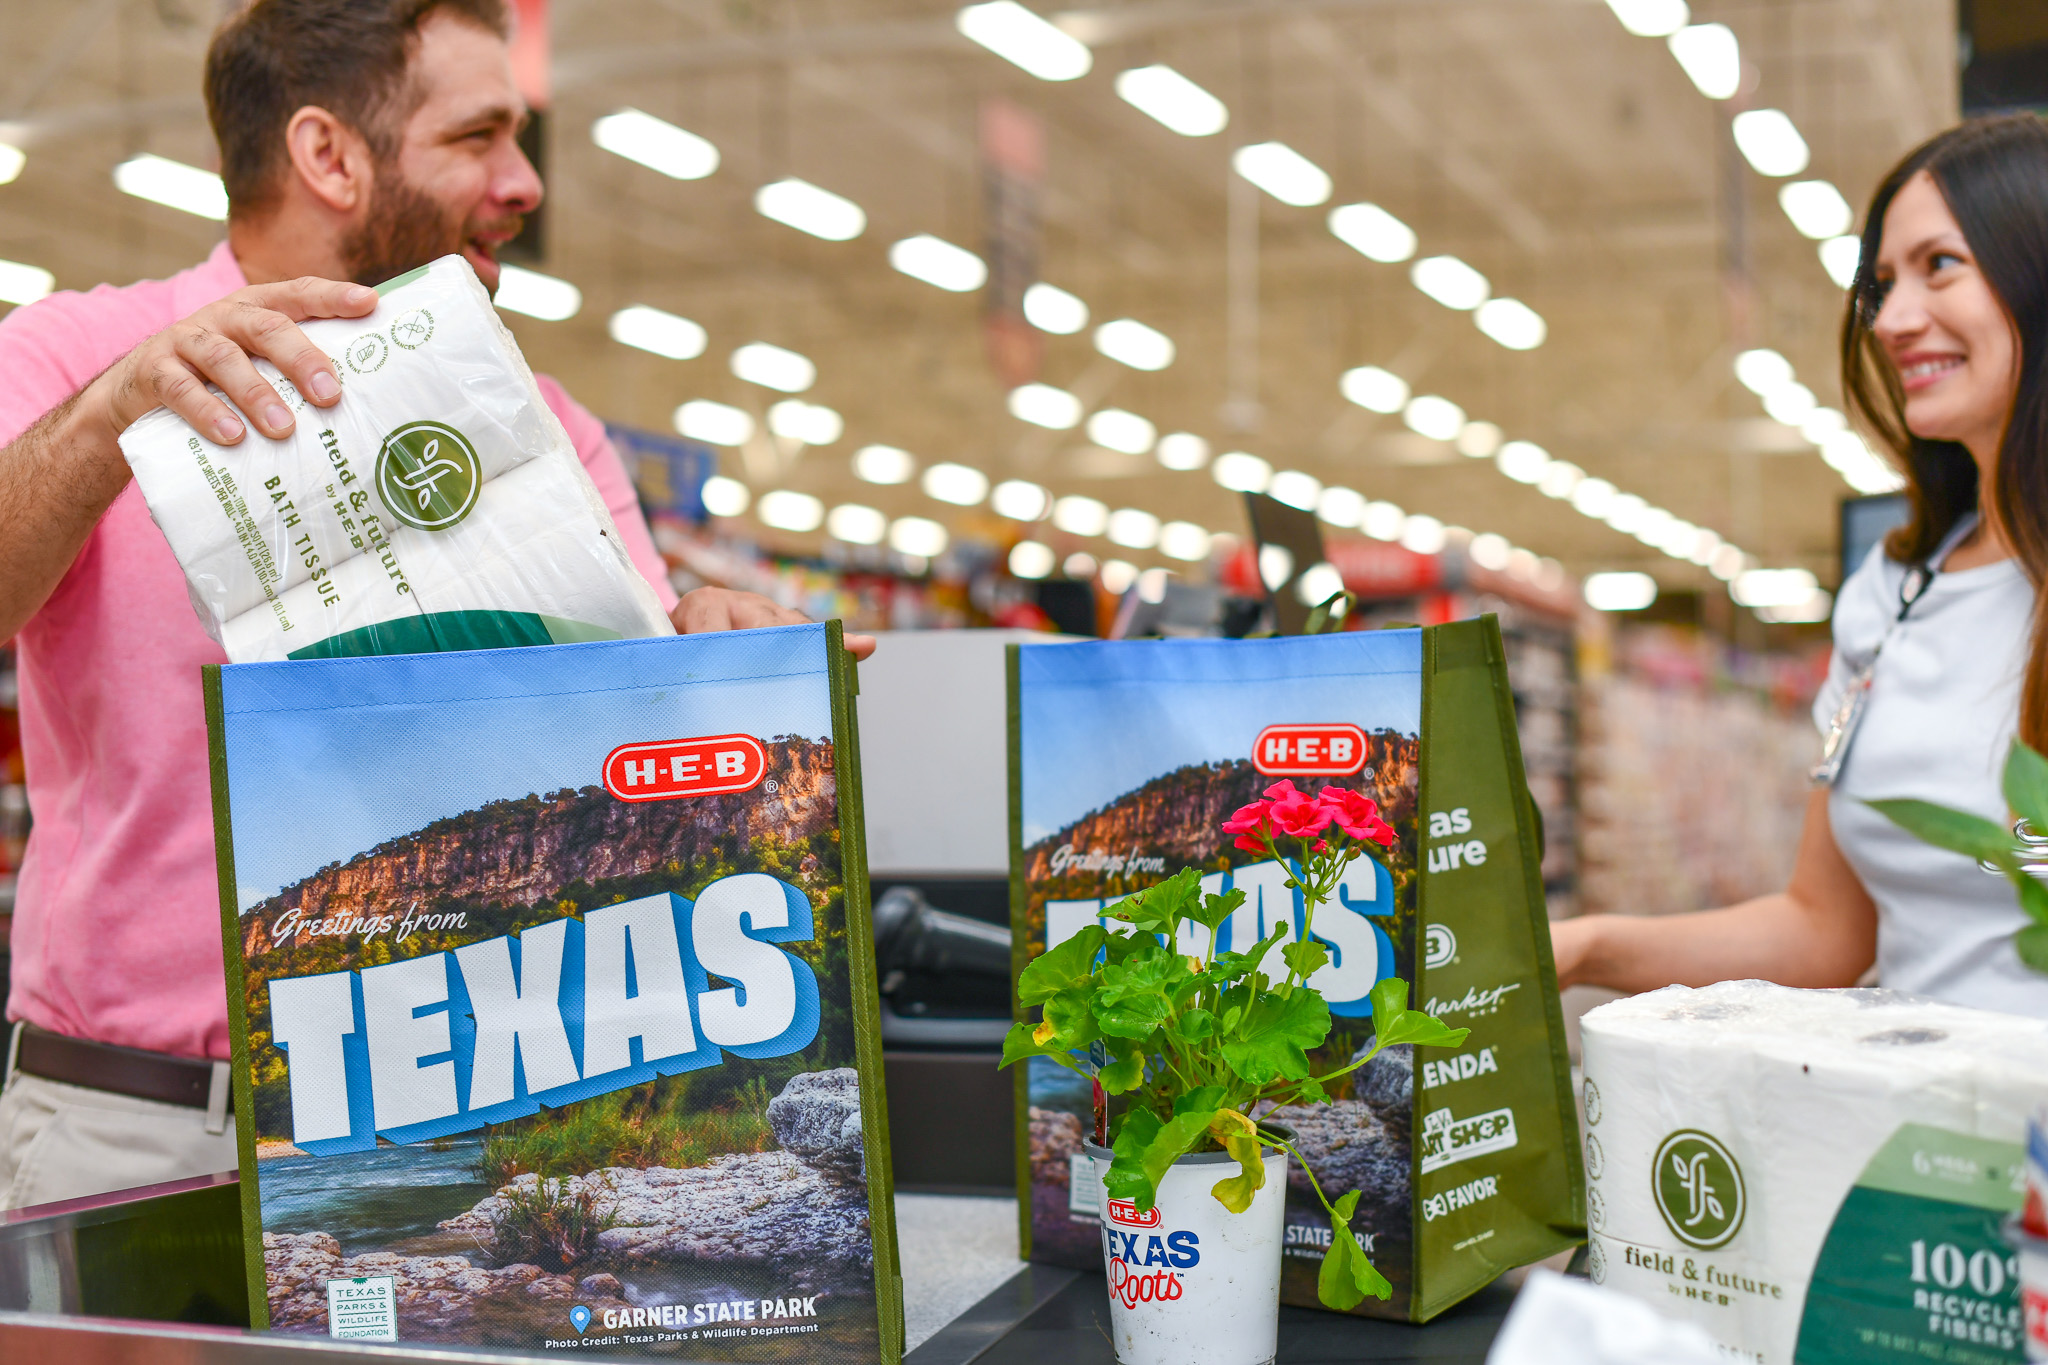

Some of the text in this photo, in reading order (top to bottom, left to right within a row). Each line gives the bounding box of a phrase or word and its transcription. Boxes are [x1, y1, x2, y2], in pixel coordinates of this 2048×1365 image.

[201, 463, 221, 490] SHEETS
[214, 486, 229, 503] PER
[325, 483, 337, 499] by
[220, 472, 238, 495] ROLLS
[233, 495, 249, 519] TOTAL
[255, 540, 267, 551] FT
[221, 499, 237, 519] ROLL
[319, 428, 410, 596] field & future
[238, 532, 250, 543] IN
[264, 475, 341, 608] BATH TISSUE
[250, 558, 262, 570] IN
[263, 583, 274, 598] cm
[623, 750, 746, 787] H-E-B
[272, 901, 468, 949] Greetings from
[268, 872, 808, 1150] TEXAS
[1445, 1175, 1498, 1212] FAVOR
[1286, 1224, 1332, 1247] STATE
[1107, 1256, 1183, 1310] Roots
[1625, 1246, 1675, 1275] field
[1682, 1258, 1699, 1281] &
[1705, 1264, 1784, 1300] future
[336, 1287, 386, 1298] TEXAS
[336, 1302, 387, 1312] PARKS &
[338, 1315, 388, 1324] WILDLIFE
[603, 1296, 817, 1330] GARNER STATE PARK
[1913, 1287, 2022, 1331] RECYCLE
[338, 1329, 389, 1339] FOUNDATION
[545, 1323, 819, 1349] Photo Credit: Texas Parks & Wildlife Department
